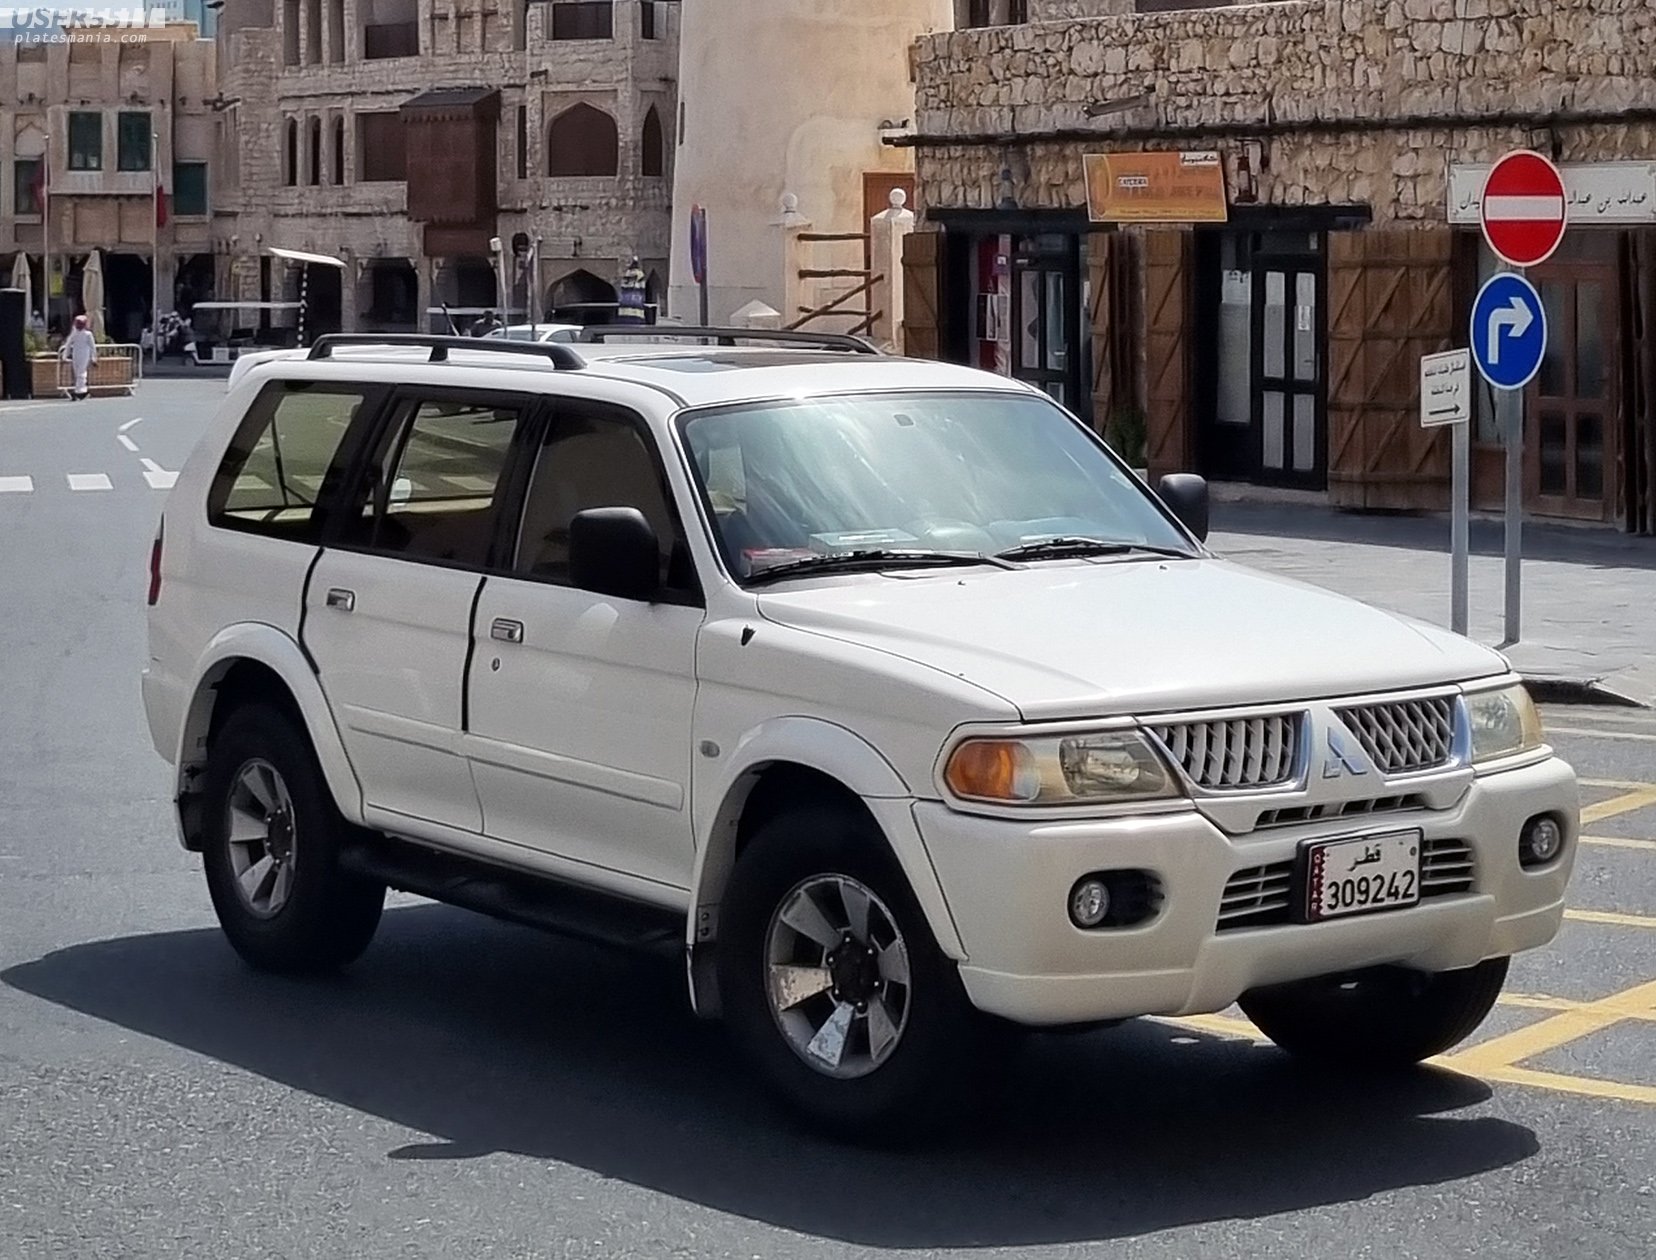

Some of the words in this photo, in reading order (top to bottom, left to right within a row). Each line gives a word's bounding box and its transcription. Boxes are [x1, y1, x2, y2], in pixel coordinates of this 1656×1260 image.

[1348, 843, 1381, 872] قطر
[1311, 853, 1321, 912] QATAR
[1326, 869, 1415, 910] 309242
